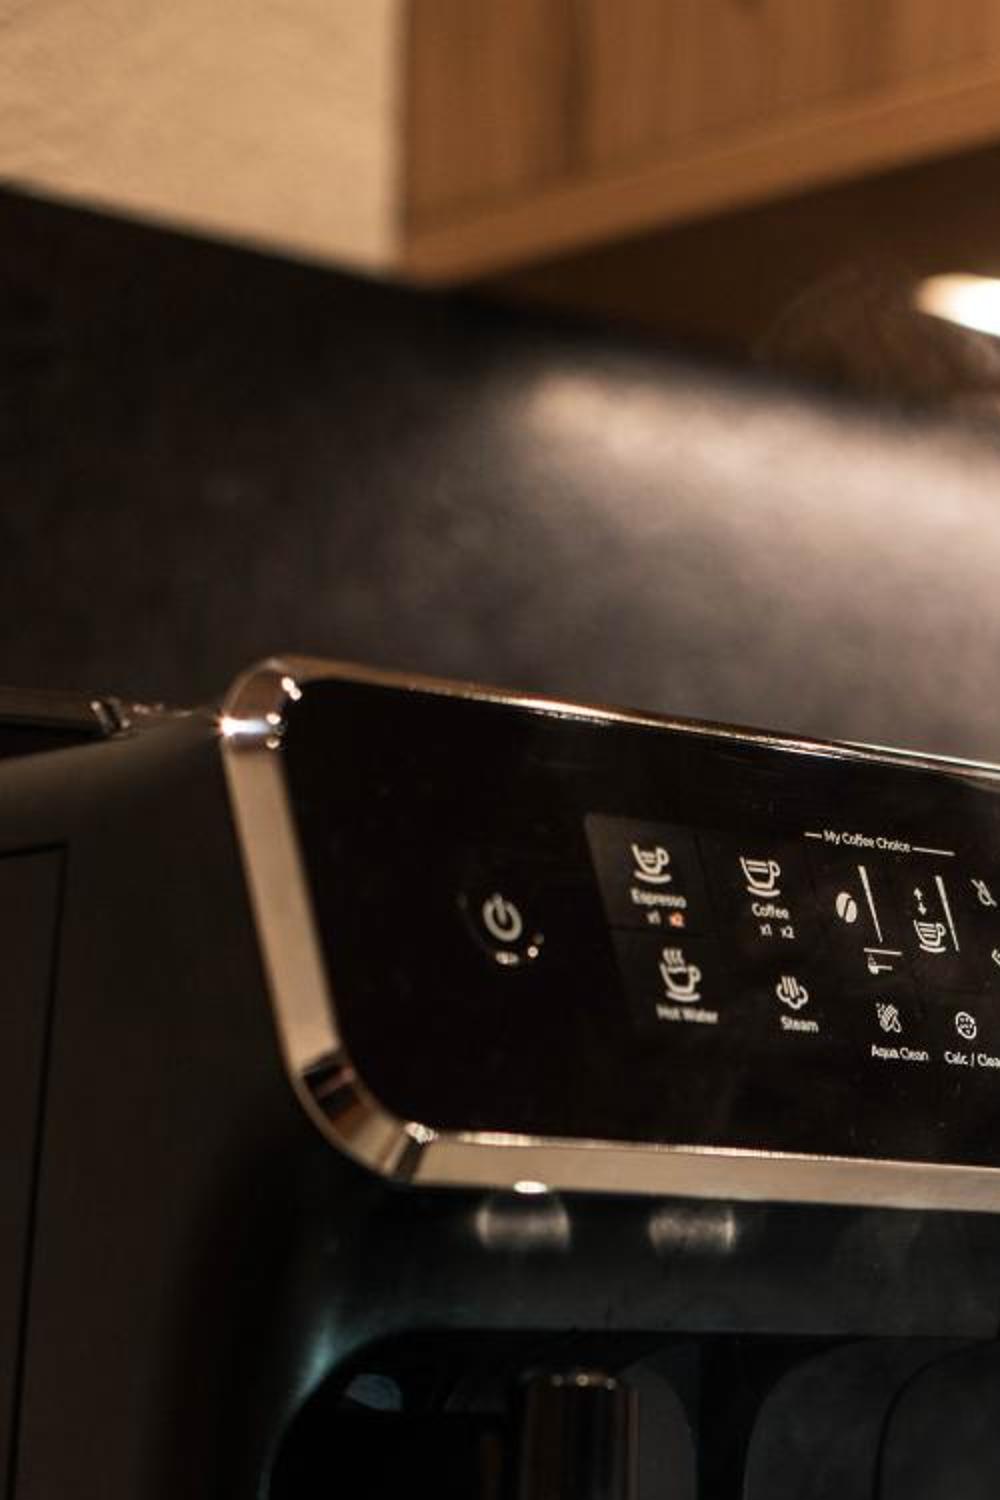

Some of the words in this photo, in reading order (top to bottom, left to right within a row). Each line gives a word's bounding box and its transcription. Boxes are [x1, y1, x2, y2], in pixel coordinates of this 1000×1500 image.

[824, 830, 840, 845] My
[842, 832, 875, 848] Coffee
[876, 837, 911, 852] Choice
[751, 902, 789, 919] Coffee
[760, 923, 772, 936] x1
[780, 925, 795, 939] x2
[657, 1004, 680, 1019] Hot
[682, 1006, 718, 1024] Water
[780, 1015, 819, 1033] Steam
[871, 1045, 899, 1060] Aqua
[899, 1048, 929, 1061] Clean
[944, 1051, 968, 1066] Calc
